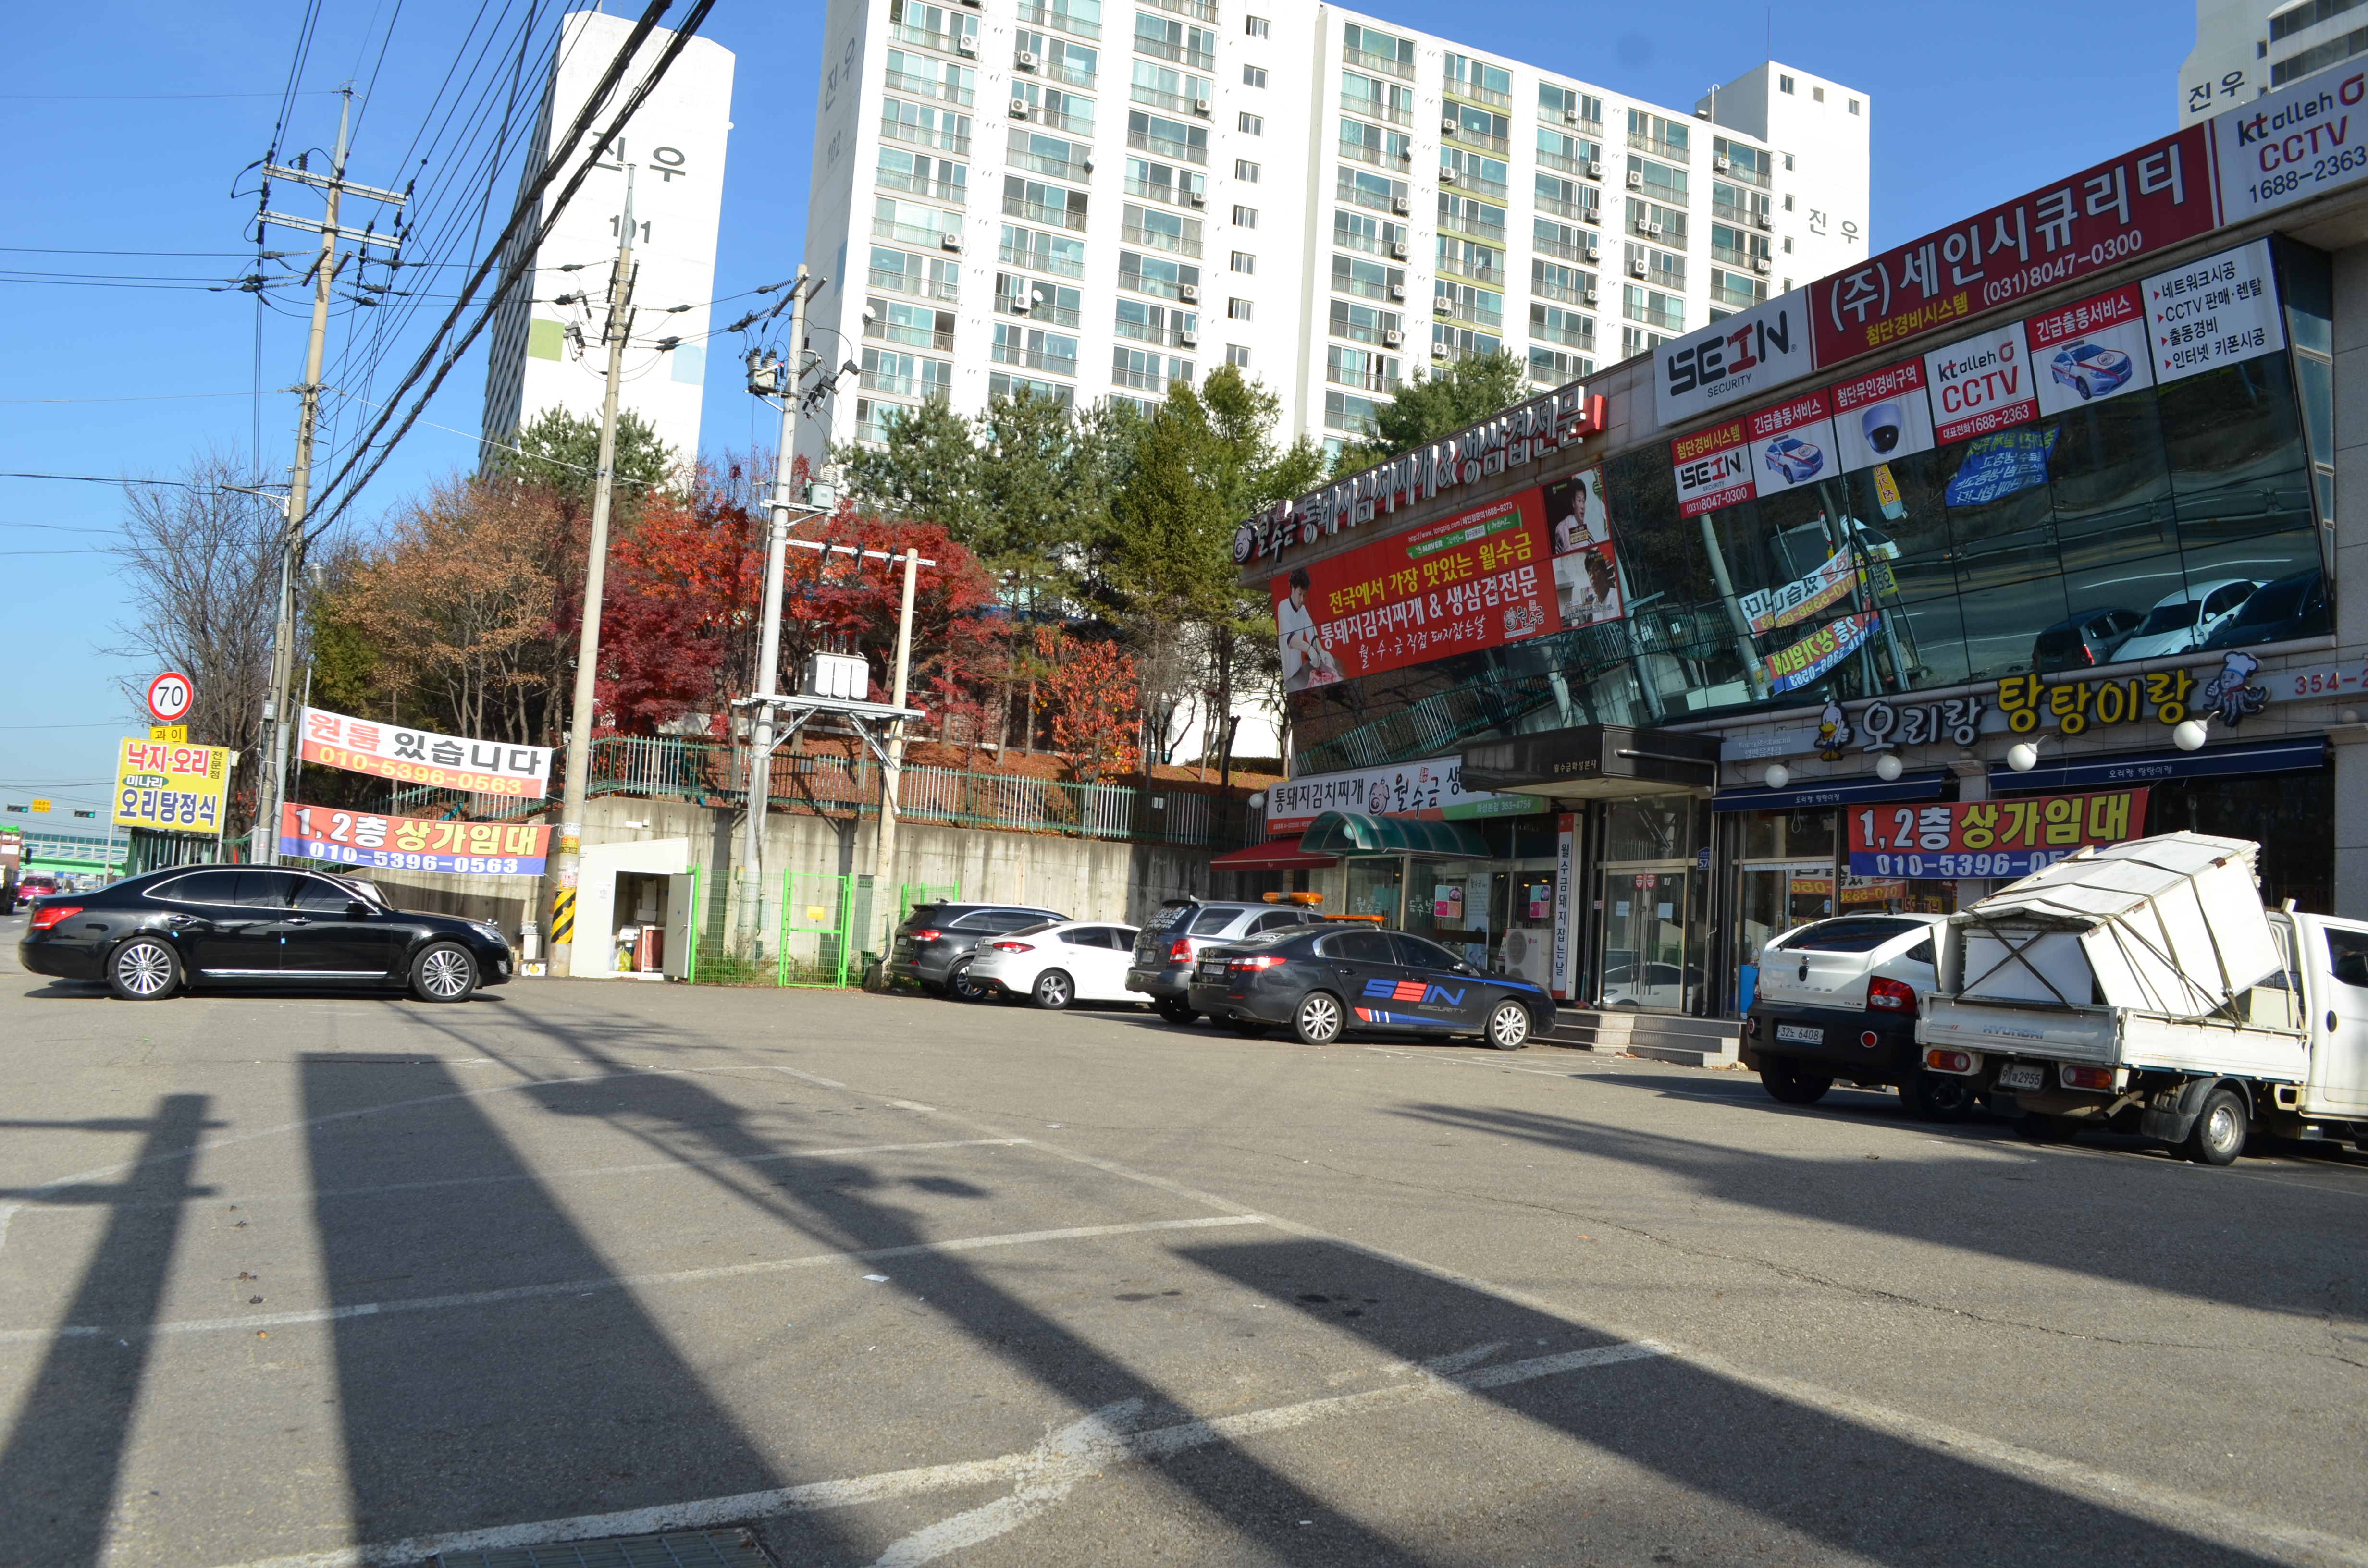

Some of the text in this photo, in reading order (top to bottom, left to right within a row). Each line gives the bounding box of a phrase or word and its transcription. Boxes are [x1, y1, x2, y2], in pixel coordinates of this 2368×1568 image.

[2189, 71, 2245, 113] 진우
[2237, 92, 2333, 147] kt olleh
[827, 130, 841, 169] 102
[2259, 115, 2347, 172] CCTV
[2249, 145, 2367, 203] 1688-2363
[1809, 208, 1859, 244] 진우
[1983, 230, 2142, 306] (031)8047-0300
[2162, 261, 2236, 299] 네트워크시공
[1866, 291, 1969, 346] 첨단경비시스템
[2036, 295, 2132, 342] 긴급출동서비스
[2165, 297, 2202, 322] CCTV
[2169, 316, 2218, 346] 출동경비
[2172, 327, 2266, 369] 인터넷 키폰시공
[1668, 310, 1789, 397] SEIN
[1938, 350, 1996, 382] kt olleh
[1707, 373, 1751, 398] SECURITY
[1838, 366, 1917, 408] 첨단무인경비구역
[1942, 366, 2018, 413] CCTV
[1754, 398, 1822, 434] 긴급출동서비스
[1970, 405, 2029, 432] 1688-2363
[1677, 423, 1741, 460] 첨단경비시스템
[1681, 452, 1742, 490] SEIN
[1702, 481, 1725, 492] SECURITY
[1686, 487, 1747, 514] (031)8047-0300
[1422, 540, 1443, 552] NAVER
[1328, 580, 1384, 615] 전국에서
[1389, 572, 1418, 596] 가장
[1423, 551, 1474, 585] 맛있는
[1478, 531, 1533, 569] 월수금
[1320, 592, 1425, 649] 통돼지김치찌개
[1430, 596, 1443, 617] &
[1445, 565, 1538, 615] 생삼겹전문
[1407, 631, 1427, 655] 직접
[158, 686, 183, 707] 70
[1863, 669, 2195, 752] 오리랑 탕탕이랑
[308, 712, 541, 775] 원룸 있습니다
[1745, 746, 1781, 759] 일반음식점
[126, 774, 163, 789] 미나리
[210, 750, 222, 779] 전문점
[319, 747, 522, 795] 010-5396-0563
[2109, 765, 2172, 779] 오리랑 탕탕이랑
[119, 788, 217, 826] 오리탕정식
[1275, 778, 1364, 813] 통돼지김치찌개
[1394, 773, 1440, 819] 월수금
[1476, 799, 1531, 813] 화성본점 353-4756
[1795, 793, 1840, 803] 오리랑 탕탕이랑
[296, 808, 387, 847] 1,2층
[395, 820, 538, 856] 상가임대
[1860, 795, 2131, 850] 1,2층 상가임대
[309, 842, 517, 874] 010-5396-0563
[1555, 844, 1569, 976] 월수금돼지잡는날
[1363, 979, 1465, 1005] SEIN
[1418, 1004, 1467, 1014] SECURITY
[1798, 1029, 1819, 1040] 6408
[1983, 1025, 2043, 1039] HYUNDAI
[2018, 1072, 2041, 1085] 2955
